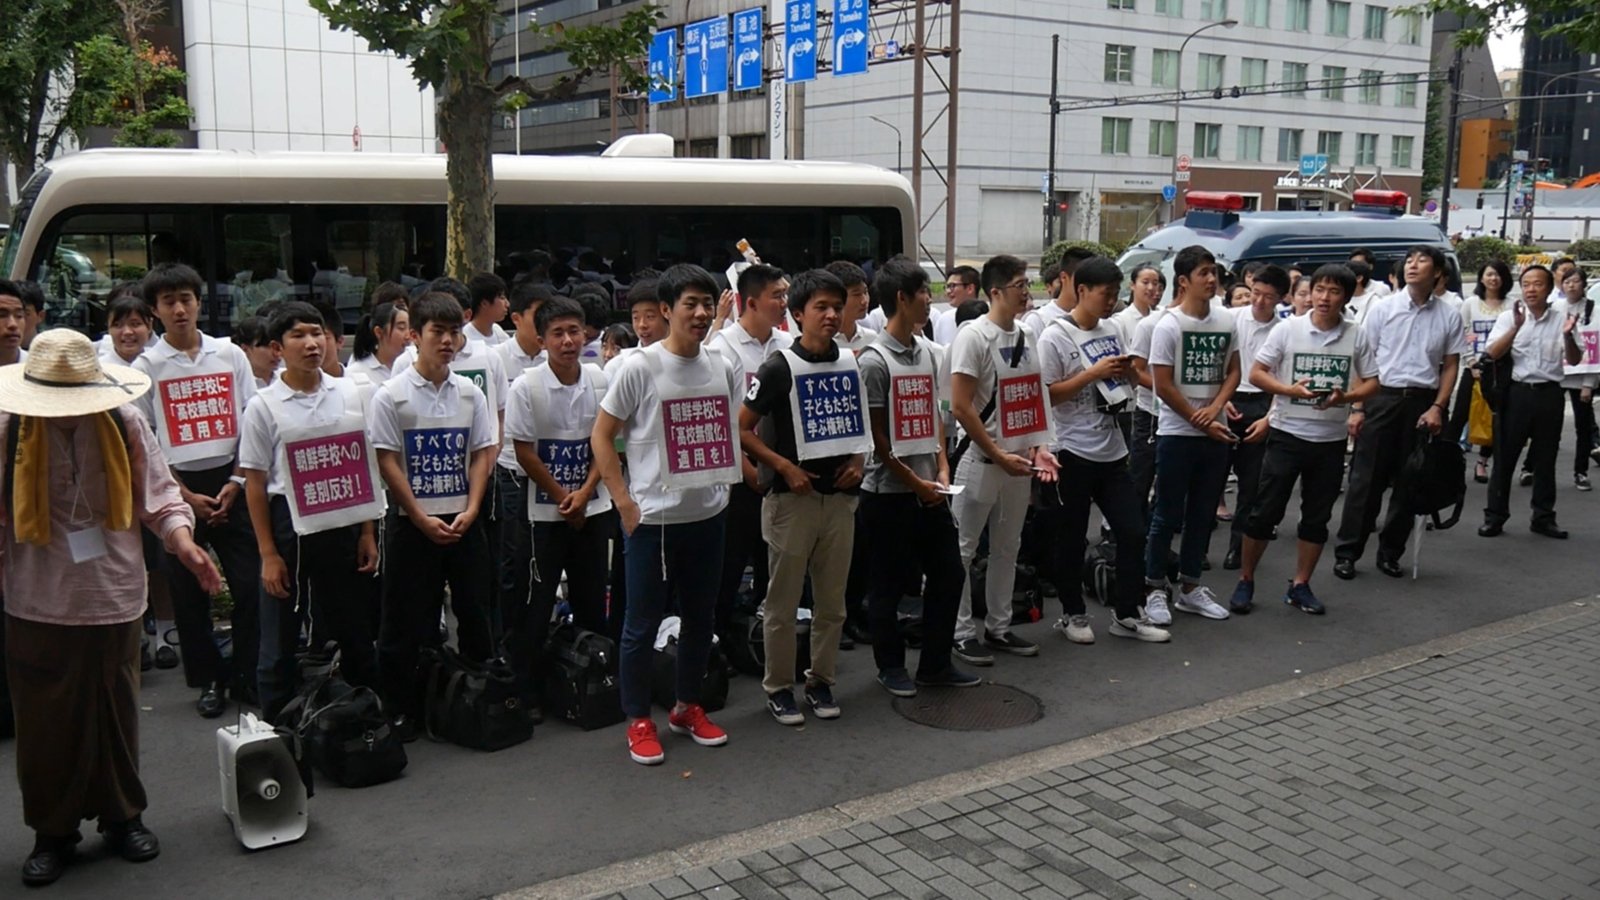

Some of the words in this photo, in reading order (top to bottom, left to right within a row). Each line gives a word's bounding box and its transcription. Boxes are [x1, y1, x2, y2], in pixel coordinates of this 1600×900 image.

[1190, 335, 1226, 349] すべての
[167, 377, 229, 401] 朝鮮学校に
[805, 375, 852, 396] すべての
[670, 399, 724, 423] 朝鮮学校に
[804, 394, 858, 417] 子どもたちに
[807, 414, 859, 439] 学ぶ権利を！
[414, 433, 465, 452] すべての
[294, 441, 361, 473] 朝鮮学校への
[303, 473, 362, 506] 差別反対！
